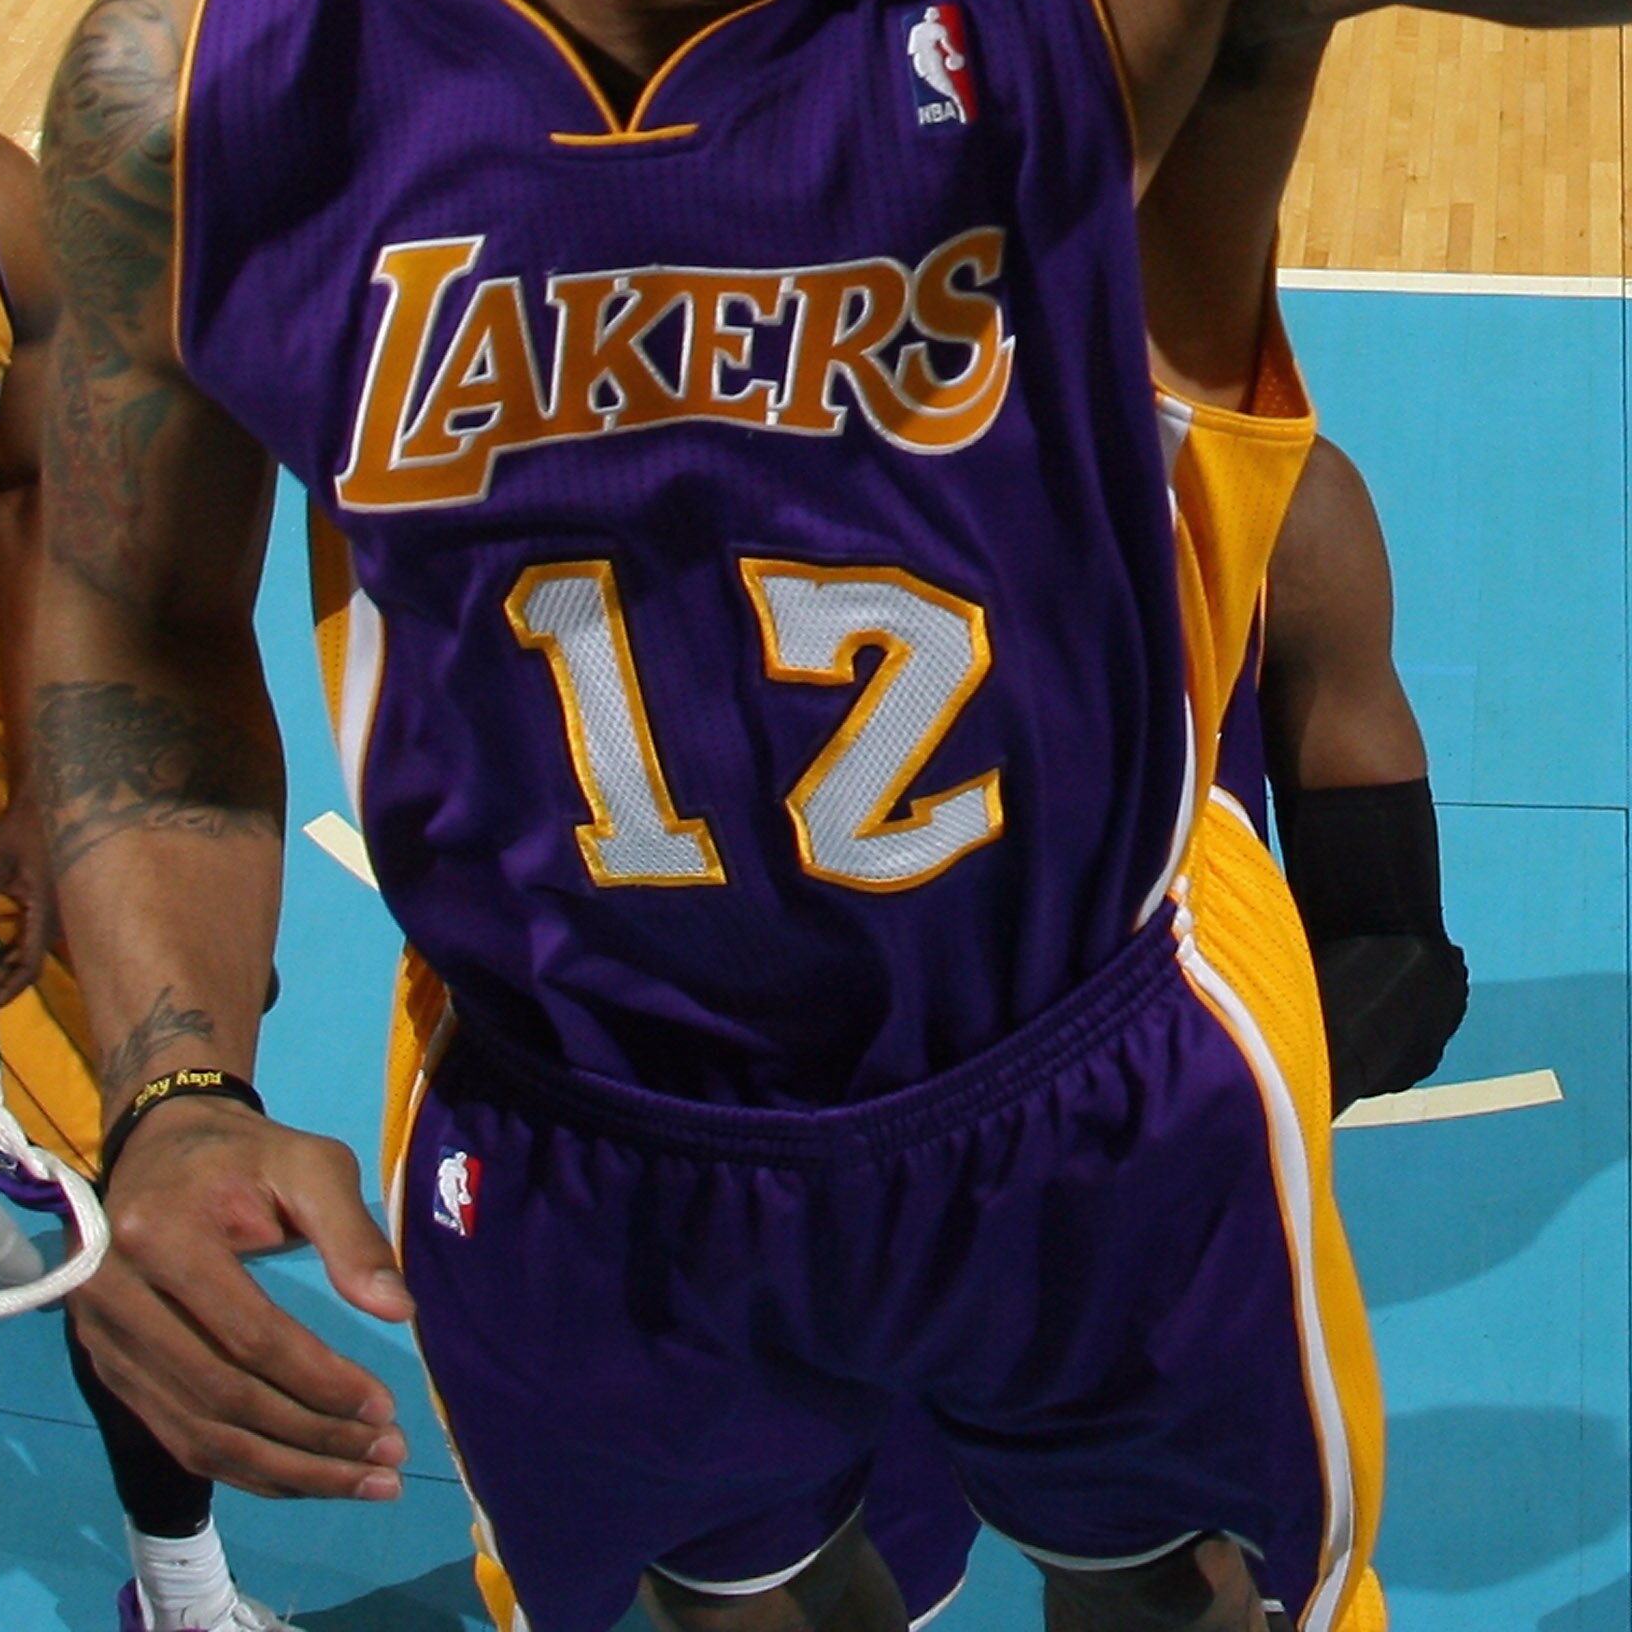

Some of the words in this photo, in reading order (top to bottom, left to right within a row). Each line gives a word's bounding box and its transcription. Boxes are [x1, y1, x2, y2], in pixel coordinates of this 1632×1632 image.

[918, 101, 957, 125] NBA
[334, 226, 1015, 514] LAKERS
[503, 558, 1004, 895] 12
